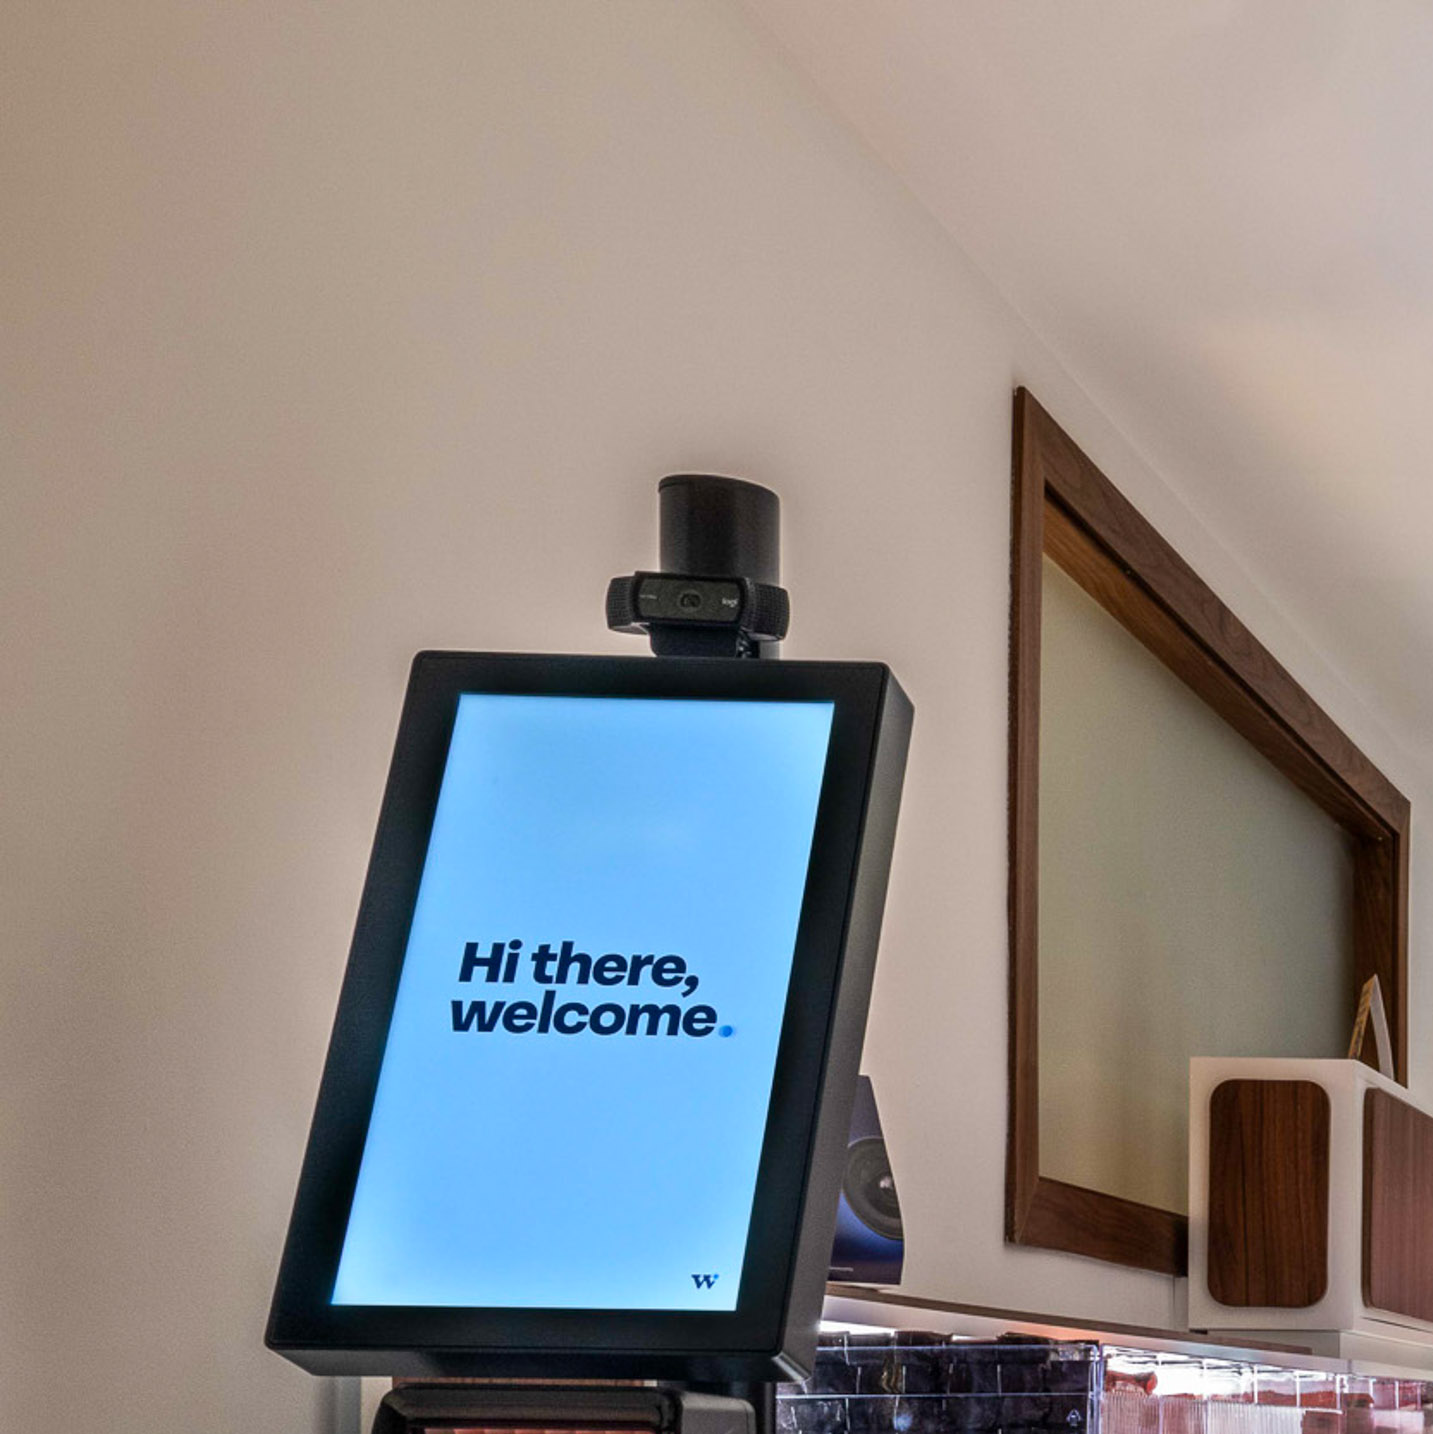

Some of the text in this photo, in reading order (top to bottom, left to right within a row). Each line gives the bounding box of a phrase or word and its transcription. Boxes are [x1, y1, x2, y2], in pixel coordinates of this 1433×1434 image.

[458, 939, 700, 999] Hi there,
[451, 989, 735, 1038] welcome.
